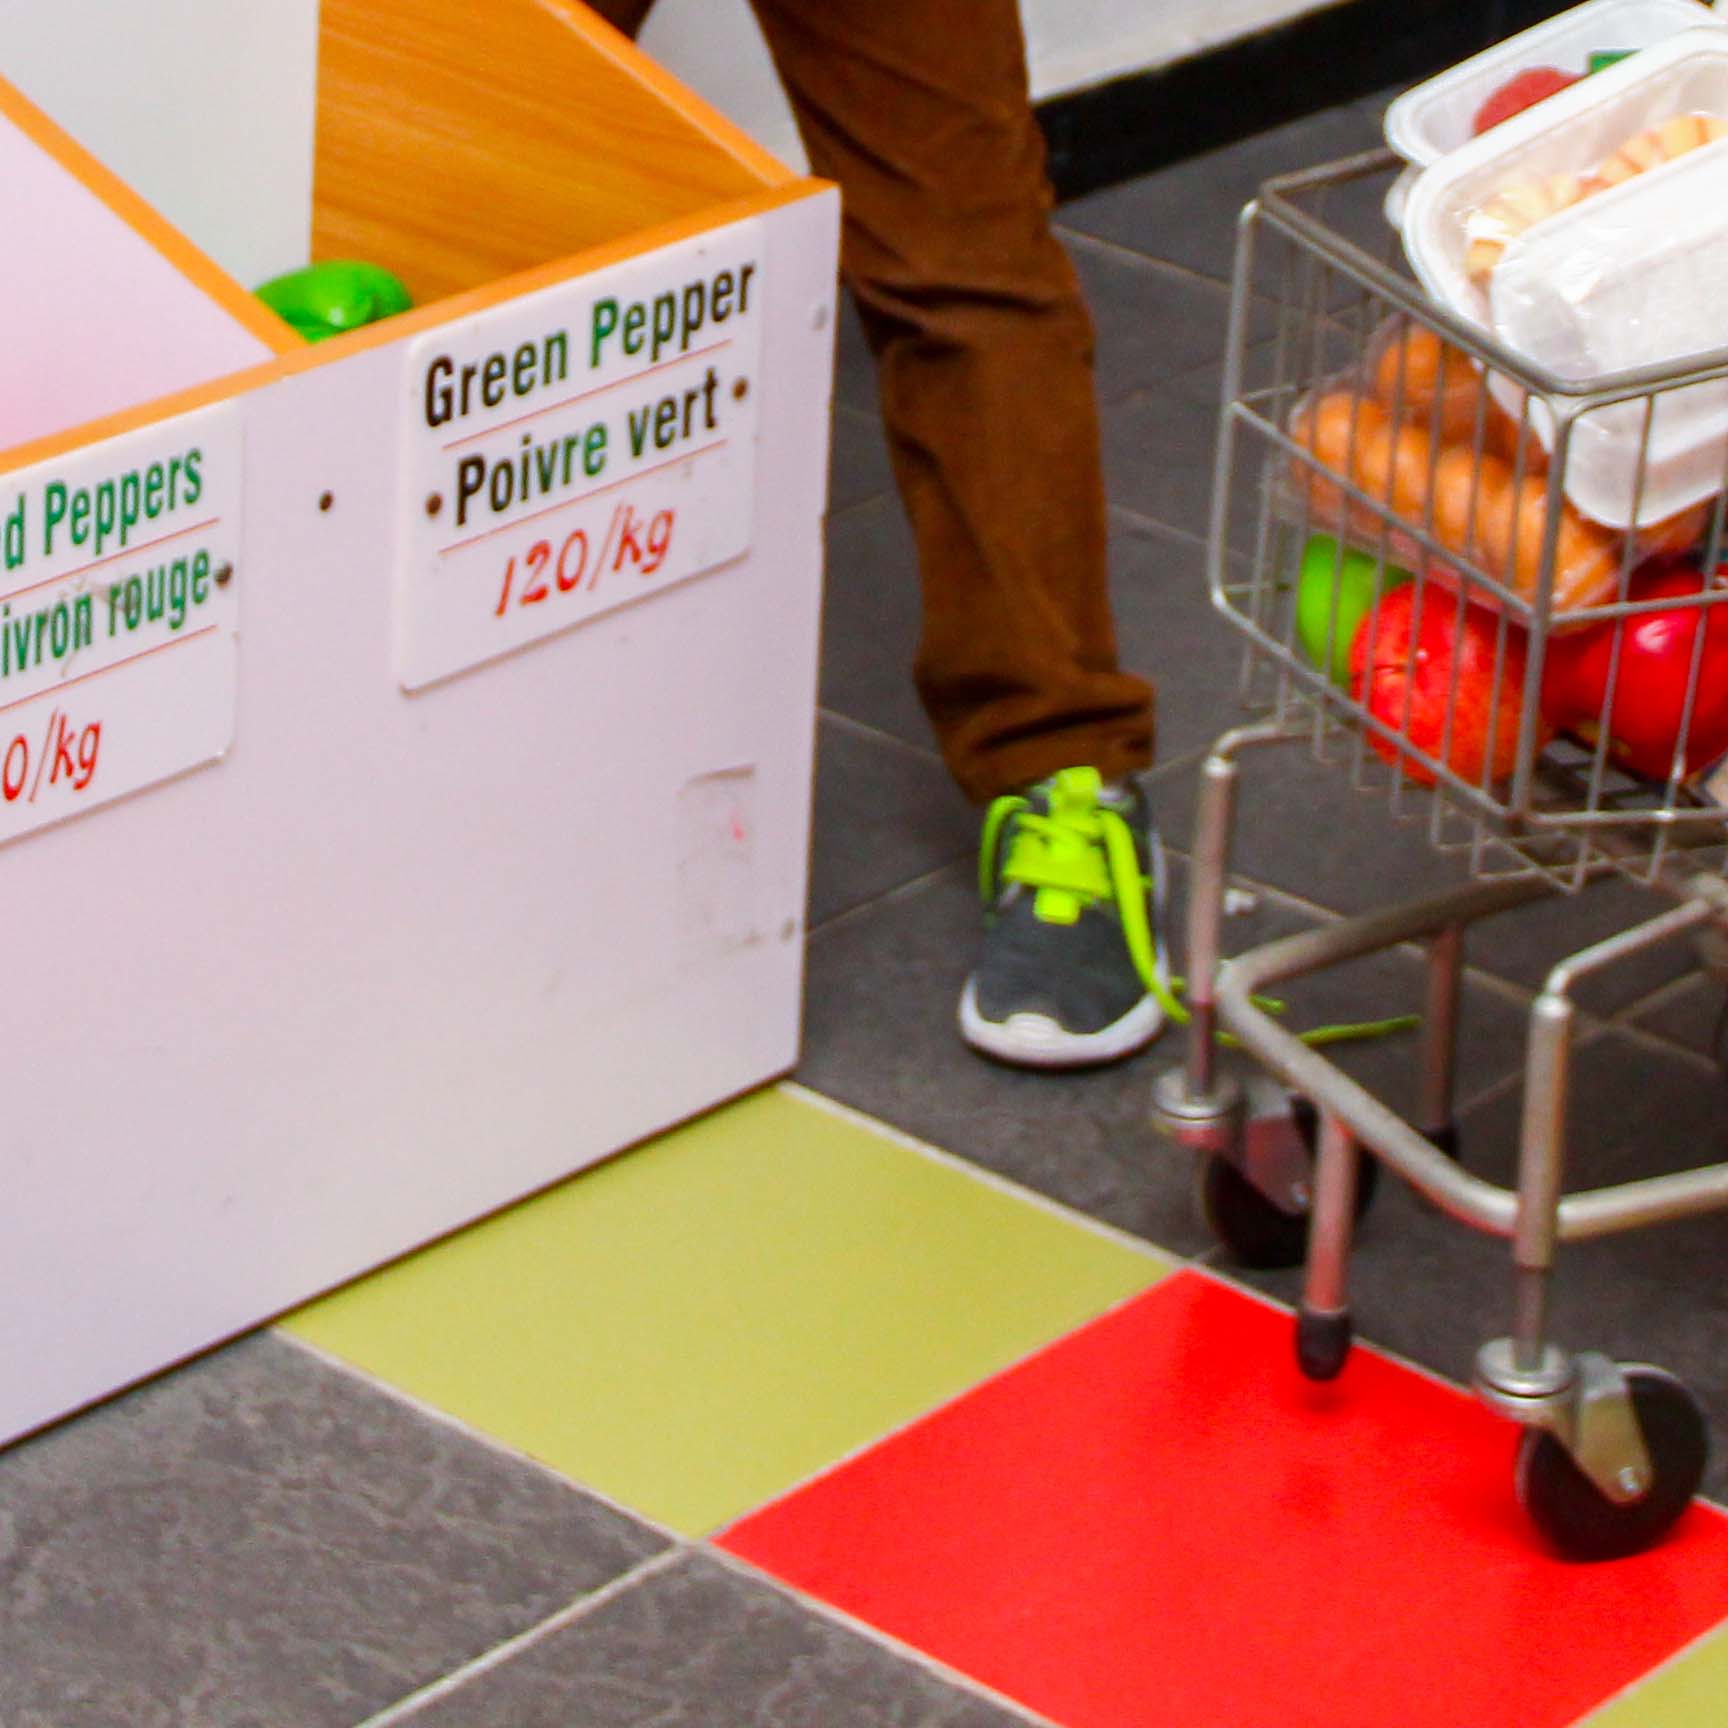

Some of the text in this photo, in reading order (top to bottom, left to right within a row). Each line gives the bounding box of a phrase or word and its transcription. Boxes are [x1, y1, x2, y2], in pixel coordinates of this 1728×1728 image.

[424, 261, 755, 429] Green Pepper
[43, 448, 203, 557] Peppers
[455, 367, 719, 527] Poivre vert
[107, 548, 212, 638] rouge
[494, 502, 677, 619] 120/kg
